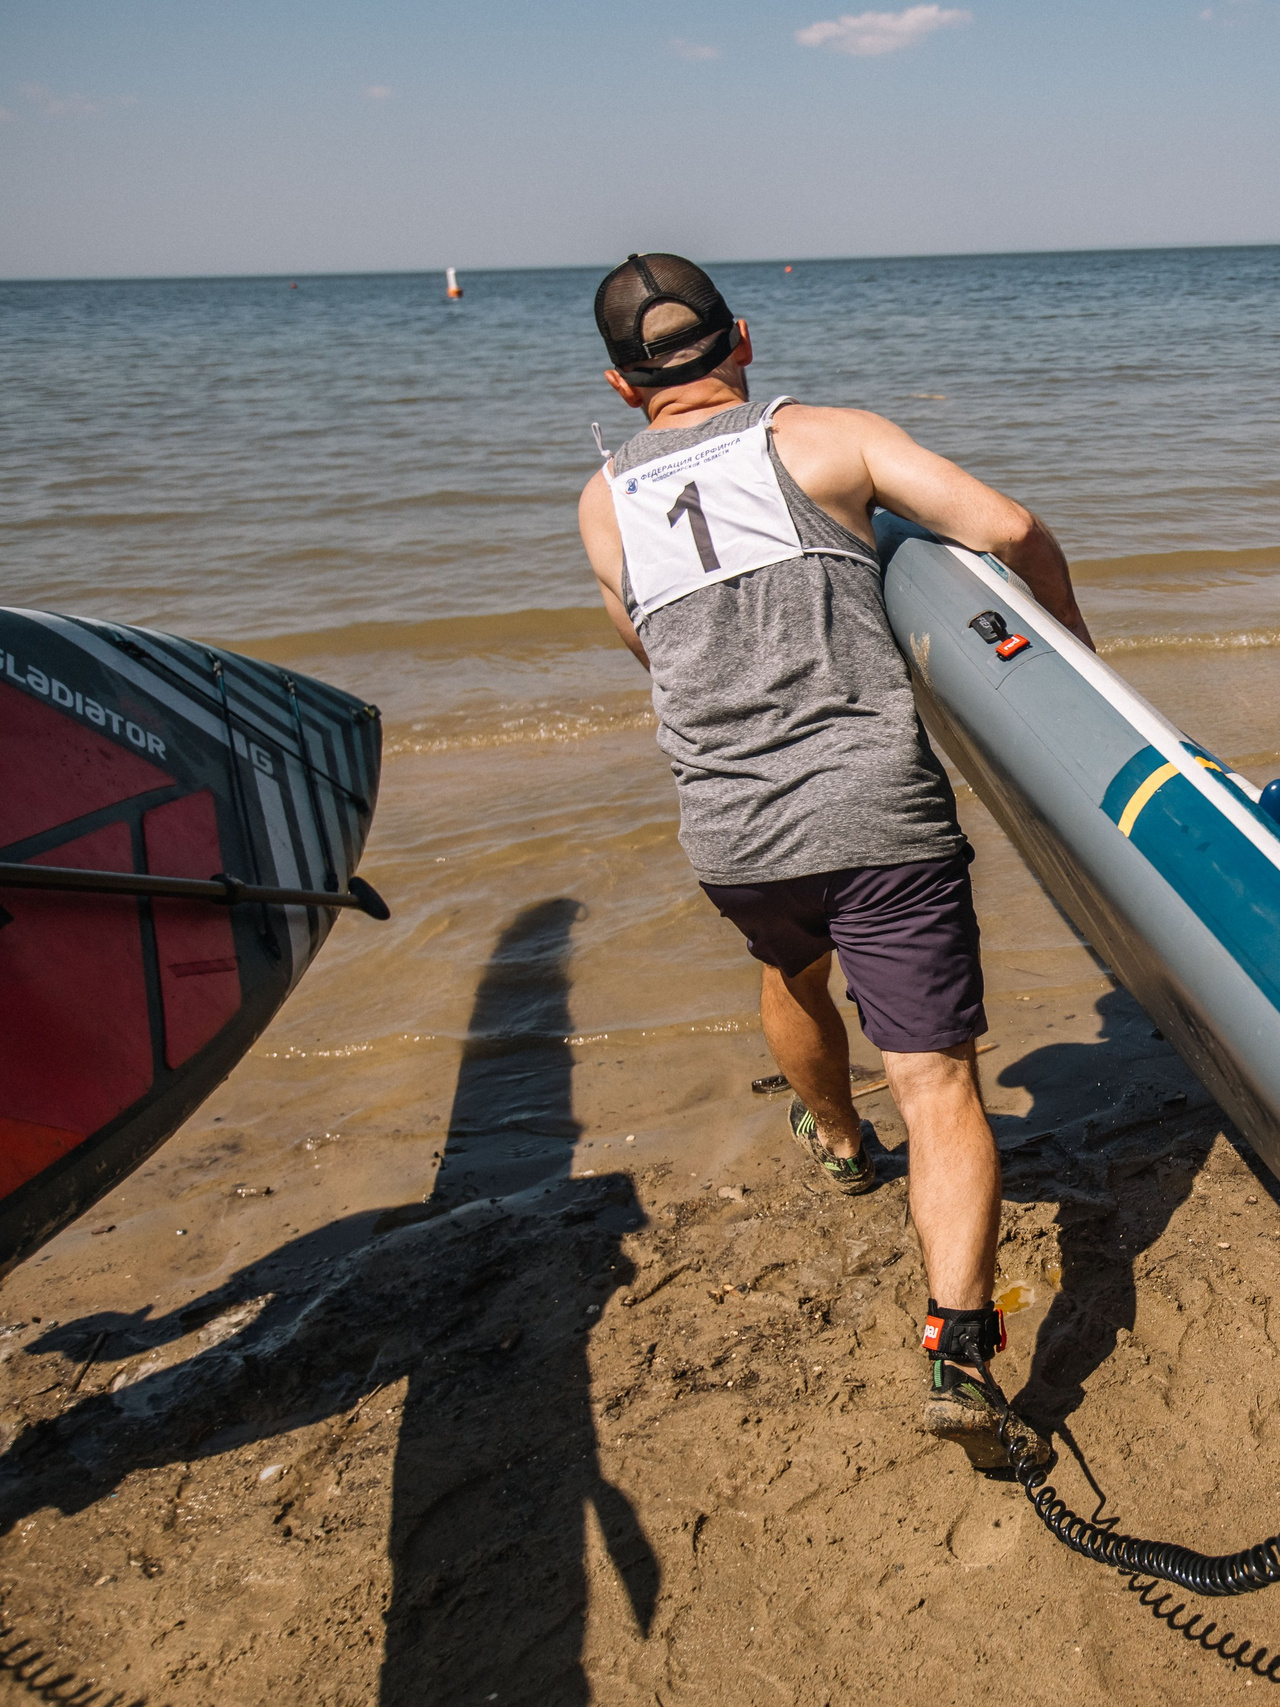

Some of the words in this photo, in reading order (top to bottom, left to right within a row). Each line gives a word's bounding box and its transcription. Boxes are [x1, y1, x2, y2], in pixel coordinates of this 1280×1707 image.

[640, 456, 693, 481] ФЕДЕРАЦИЯ
[694, 437, 741, 461] СЕРФИНГА
[652, 461, 700, 483] НОВОСИБИРСКОЙ
[703, 448, 730, 464] ОБЛАСТИ
[666, 481, 721, 574] 1
